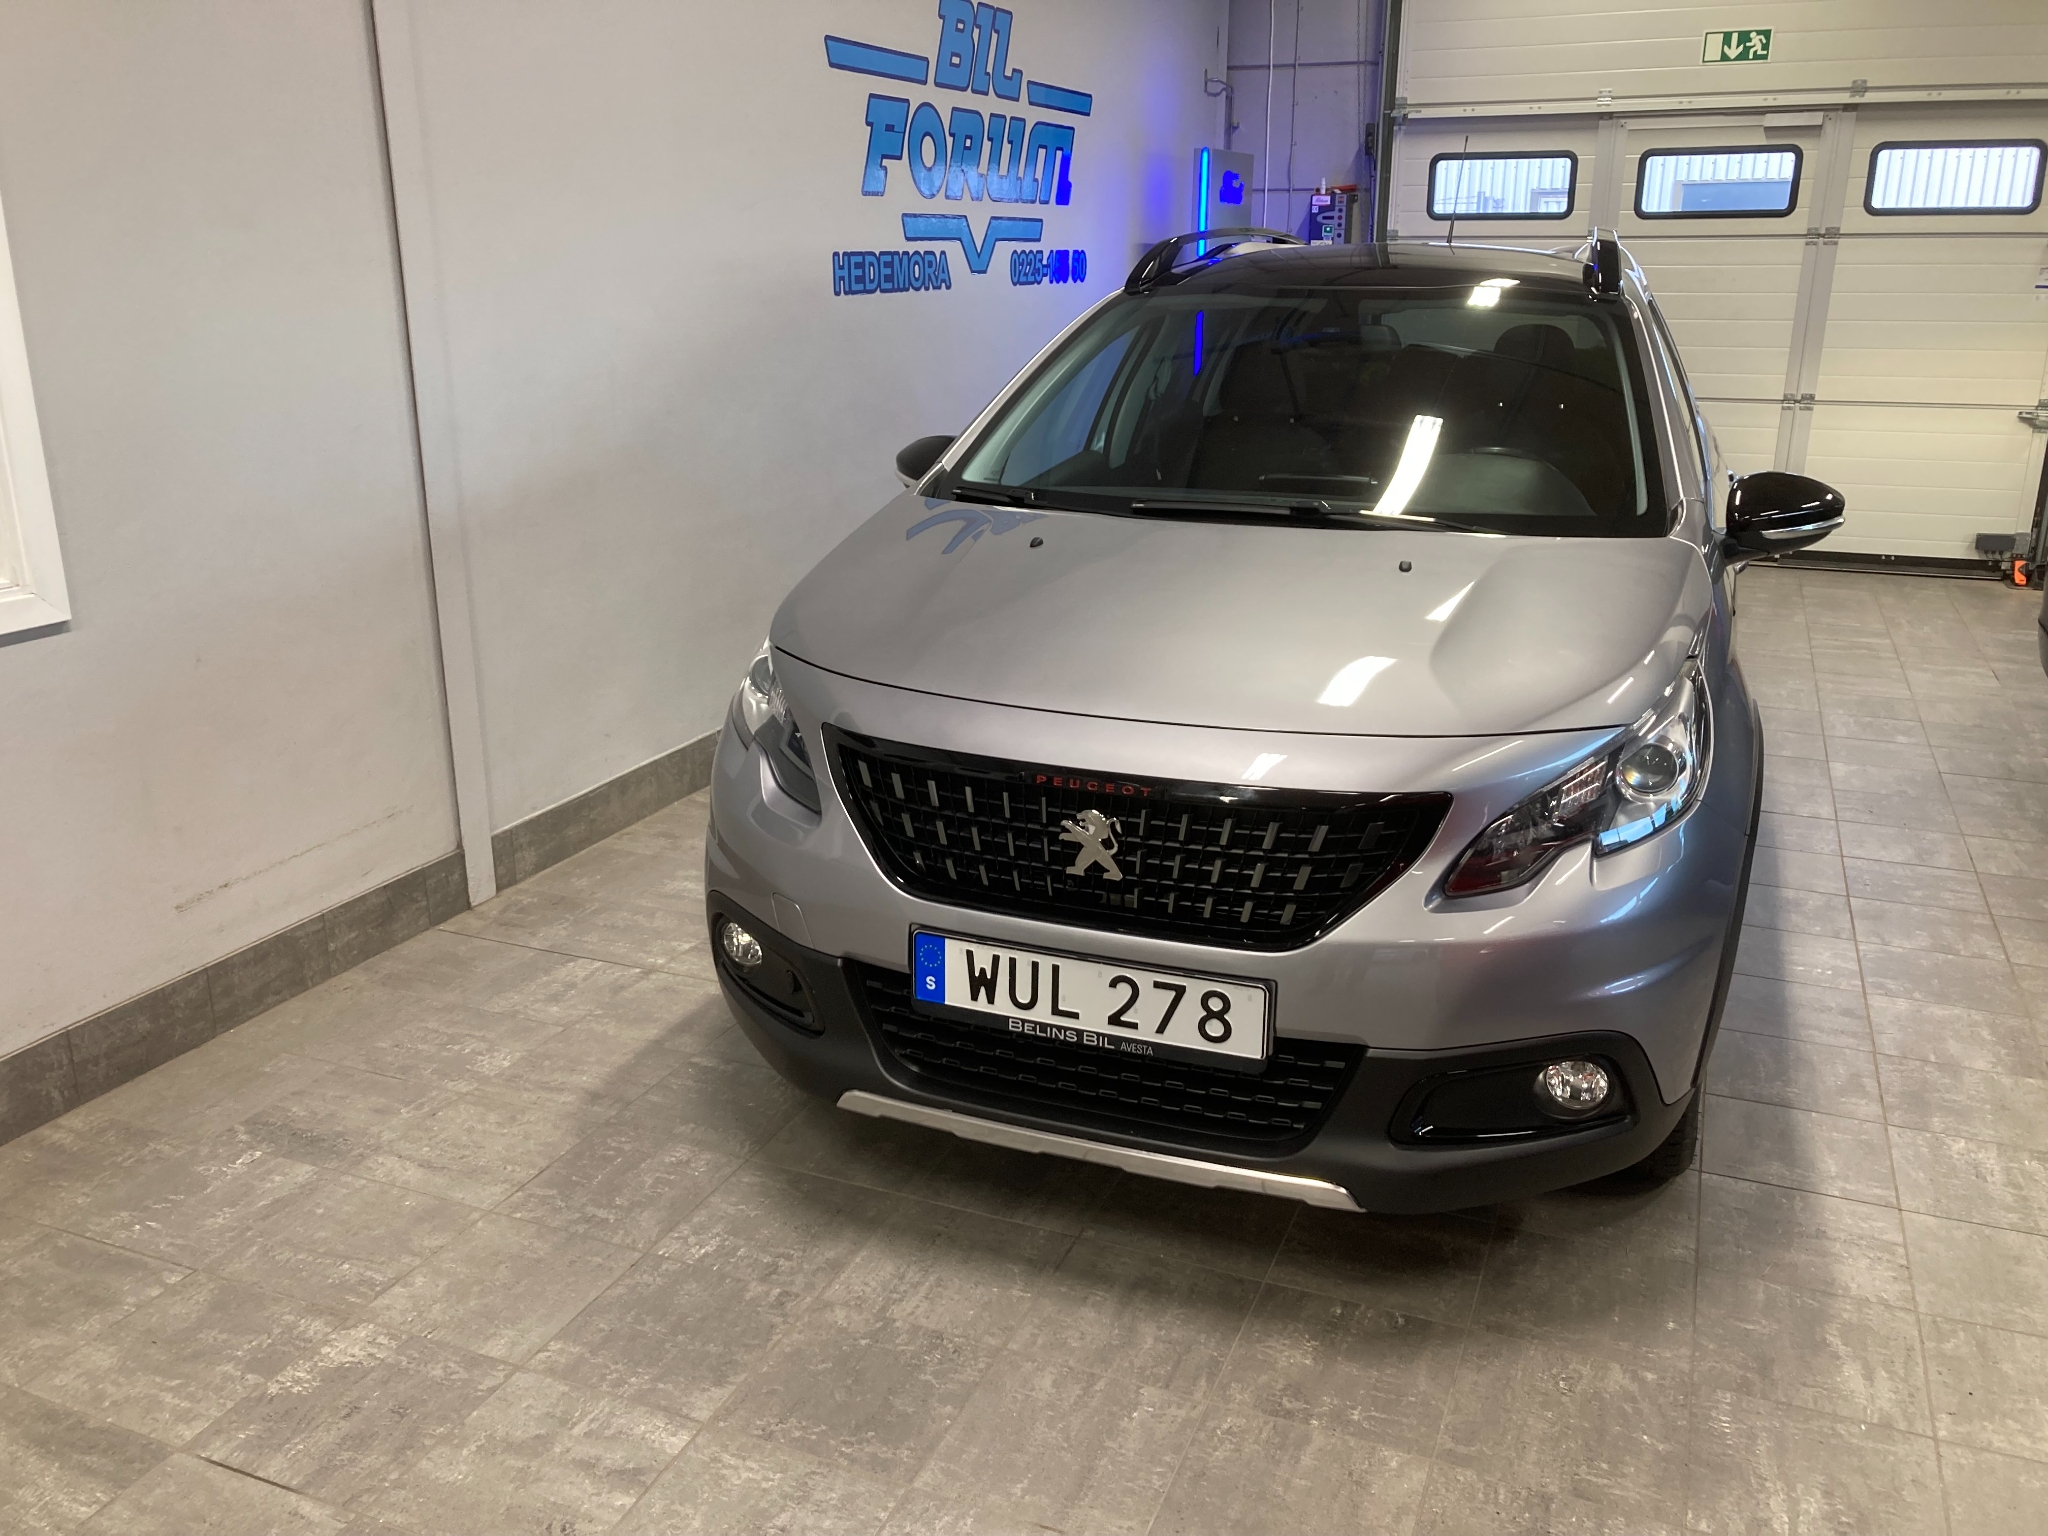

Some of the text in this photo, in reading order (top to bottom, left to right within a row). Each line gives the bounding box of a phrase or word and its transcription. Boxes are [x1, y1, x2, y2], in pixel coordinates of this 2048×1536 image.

[934, 0, 1023, 102] BIL
[861, 93, 1075, 206] FORUM
[832, 250, 952, 296] HEDEMORA
[1036, 774, 1152, 797] PEUGEOT
[925, 975, 936, 990] S
[965, 948, 1232, 1044] WUL 278
[1008, 1018, 1154, 1056] BELINS BIL AVESTA
